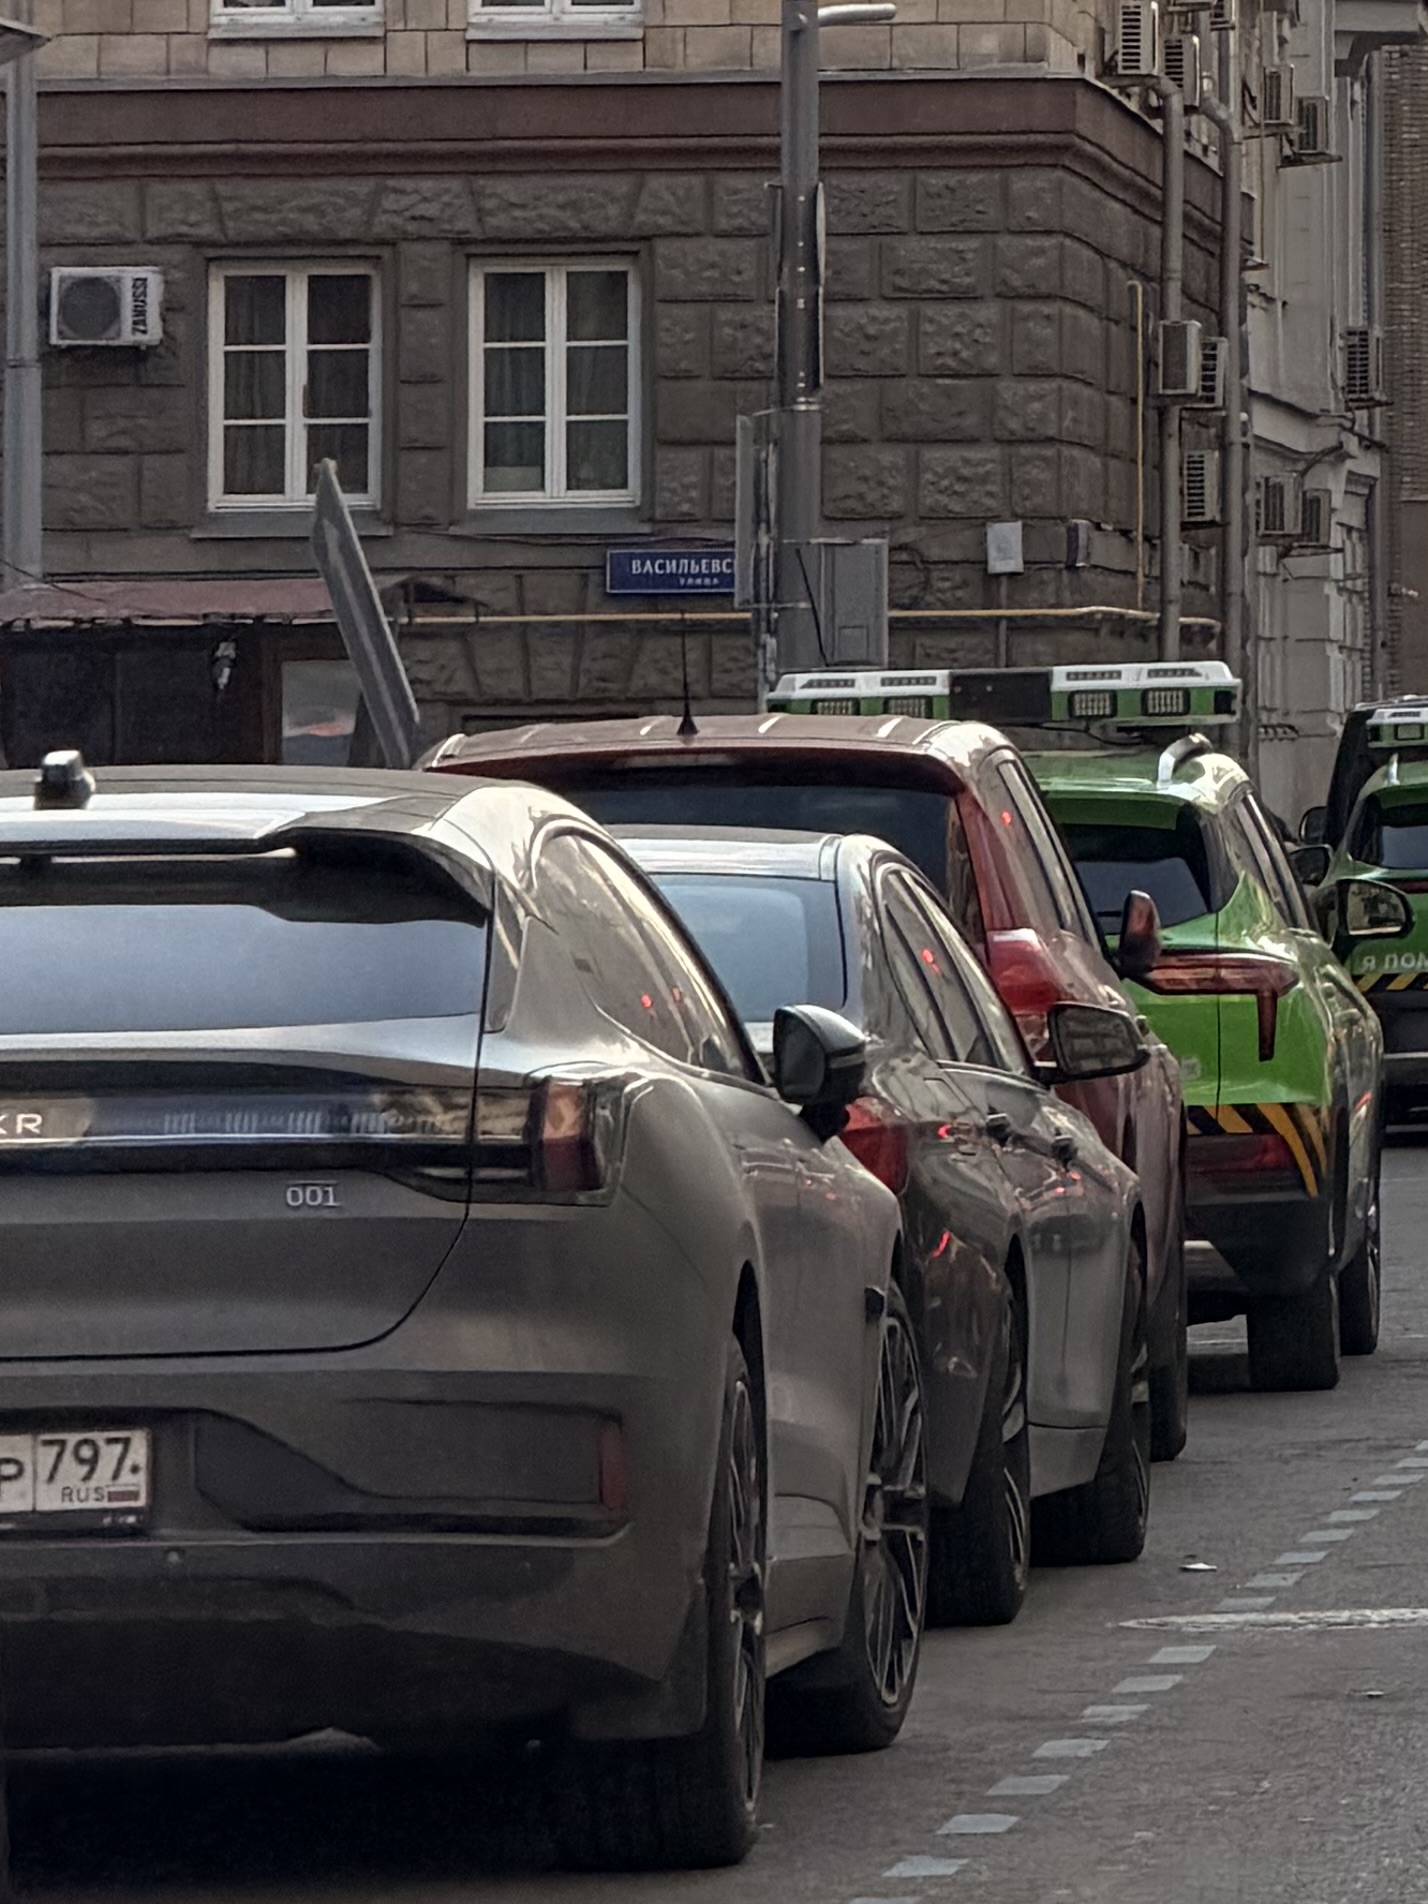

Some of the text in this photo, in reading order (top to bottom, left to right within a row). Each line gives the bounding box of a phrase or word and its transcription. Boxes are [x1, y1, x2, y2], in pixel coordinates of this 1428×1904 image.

[286, 1185, 342, 1207] 001
[41, 1437, 132, 1484] 797
[61, 1486, 105, 1503] RUS
